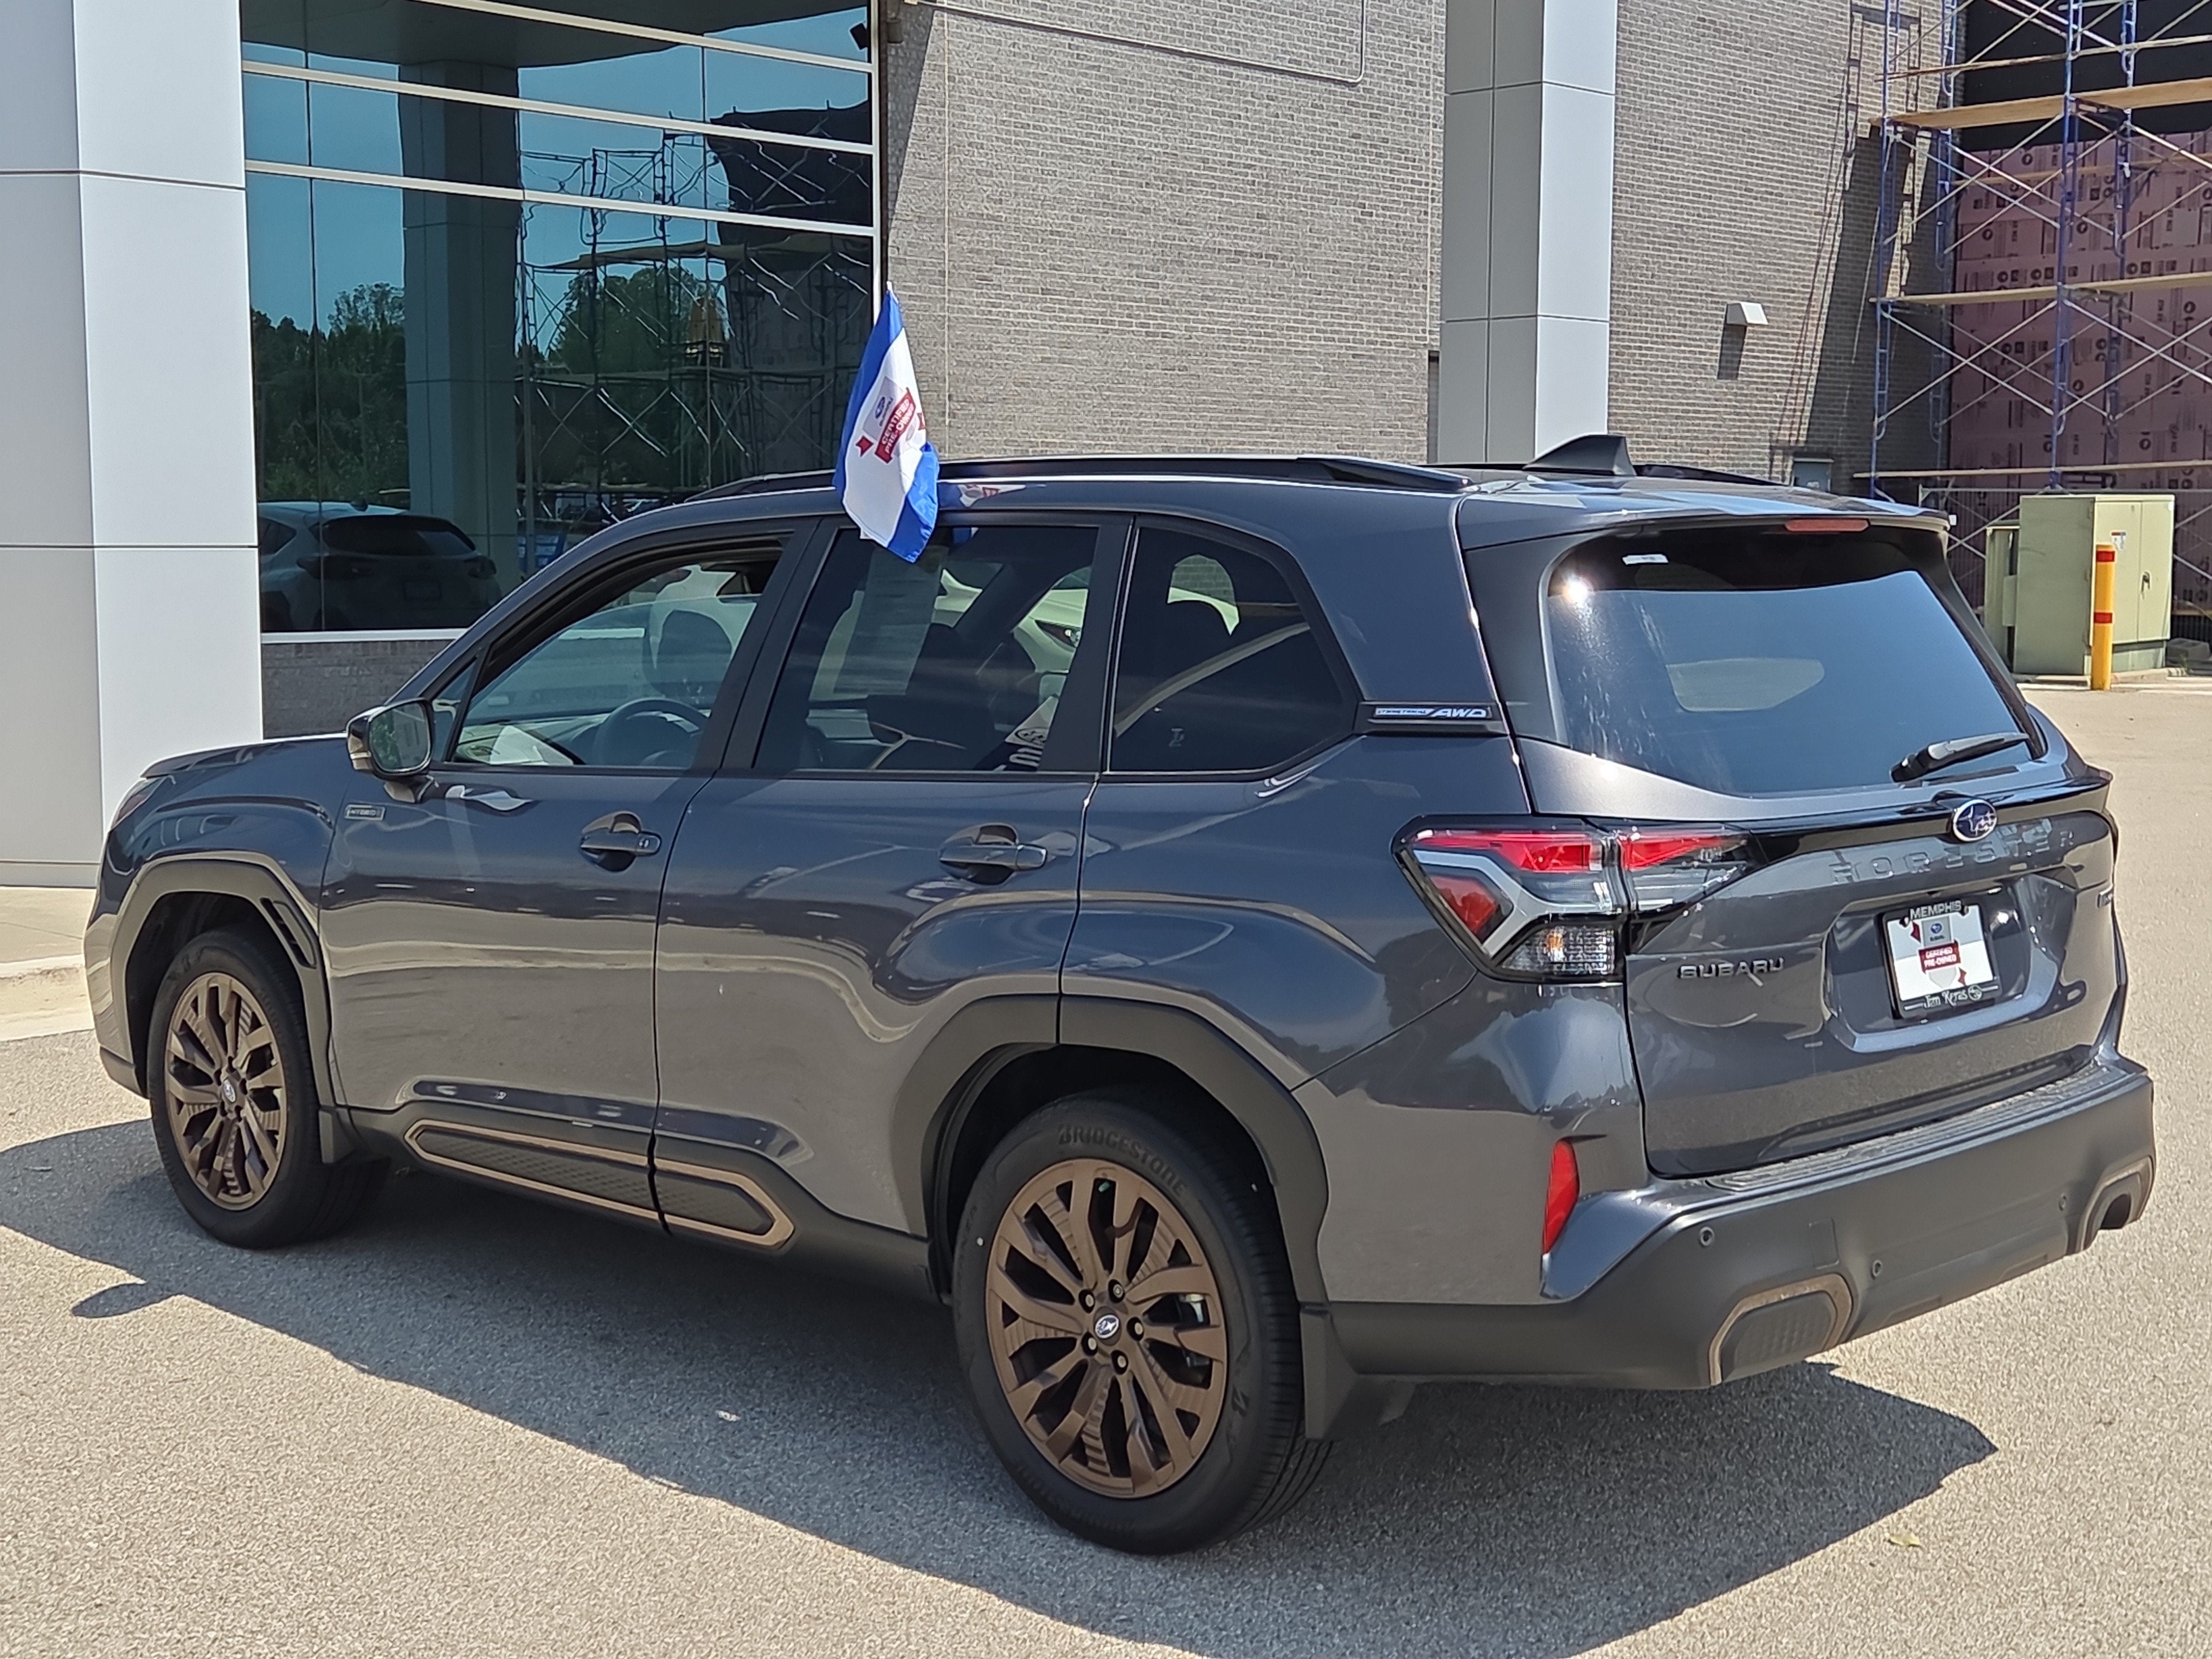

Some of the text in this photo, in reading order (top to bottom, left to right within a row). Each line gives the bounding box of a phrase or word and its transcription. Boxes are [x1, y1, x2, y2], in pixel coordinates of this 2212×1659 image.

[1430, 708, 1487, 718] AWD
[1910, 900, 1962, 920] MEMPHIS
[1678, 957, 1784, 978] SUBARU
